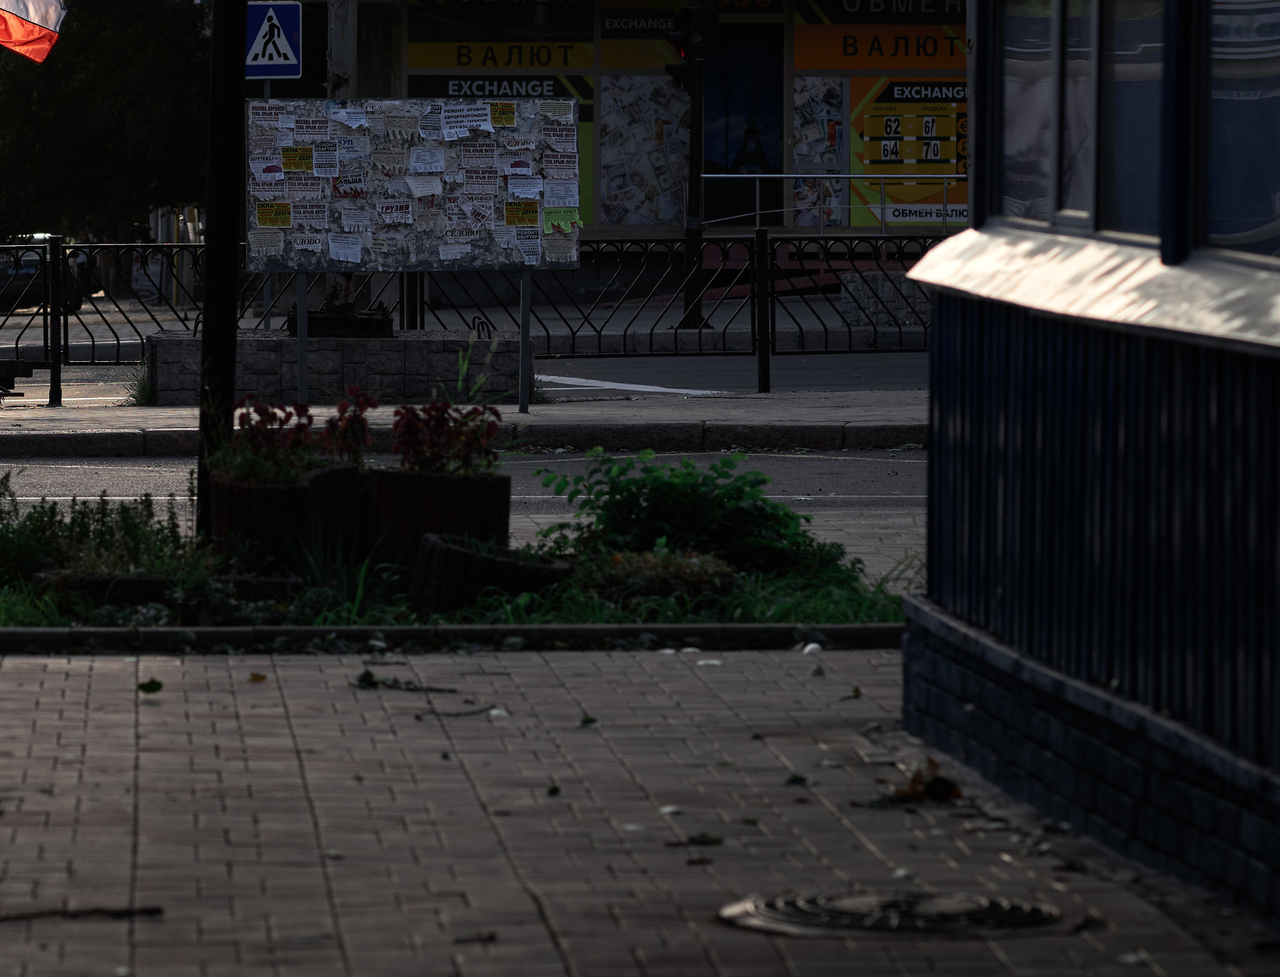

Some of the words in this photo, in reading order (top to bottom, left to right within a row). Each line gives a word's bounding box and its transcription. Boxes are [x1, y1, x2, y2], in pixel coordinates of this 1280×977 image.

[605, 18, 674, 29] EXCHANGE
[843, 35, 960, 57] ВАЛЮТ
[456, 45, 575, 66] ВАЛЮТ
[448, 80, 555, 96] EXCHANGE
[893, 86, 967, 98] EXCHANG
[884, 118, 901, 135] 62
[882, 141, 899, 158] 64
[923, 141, 939, 159] 70
[892, 209, 932, 218] ОБМЕН
[445, 229, 479, 238] СЕДОВО
